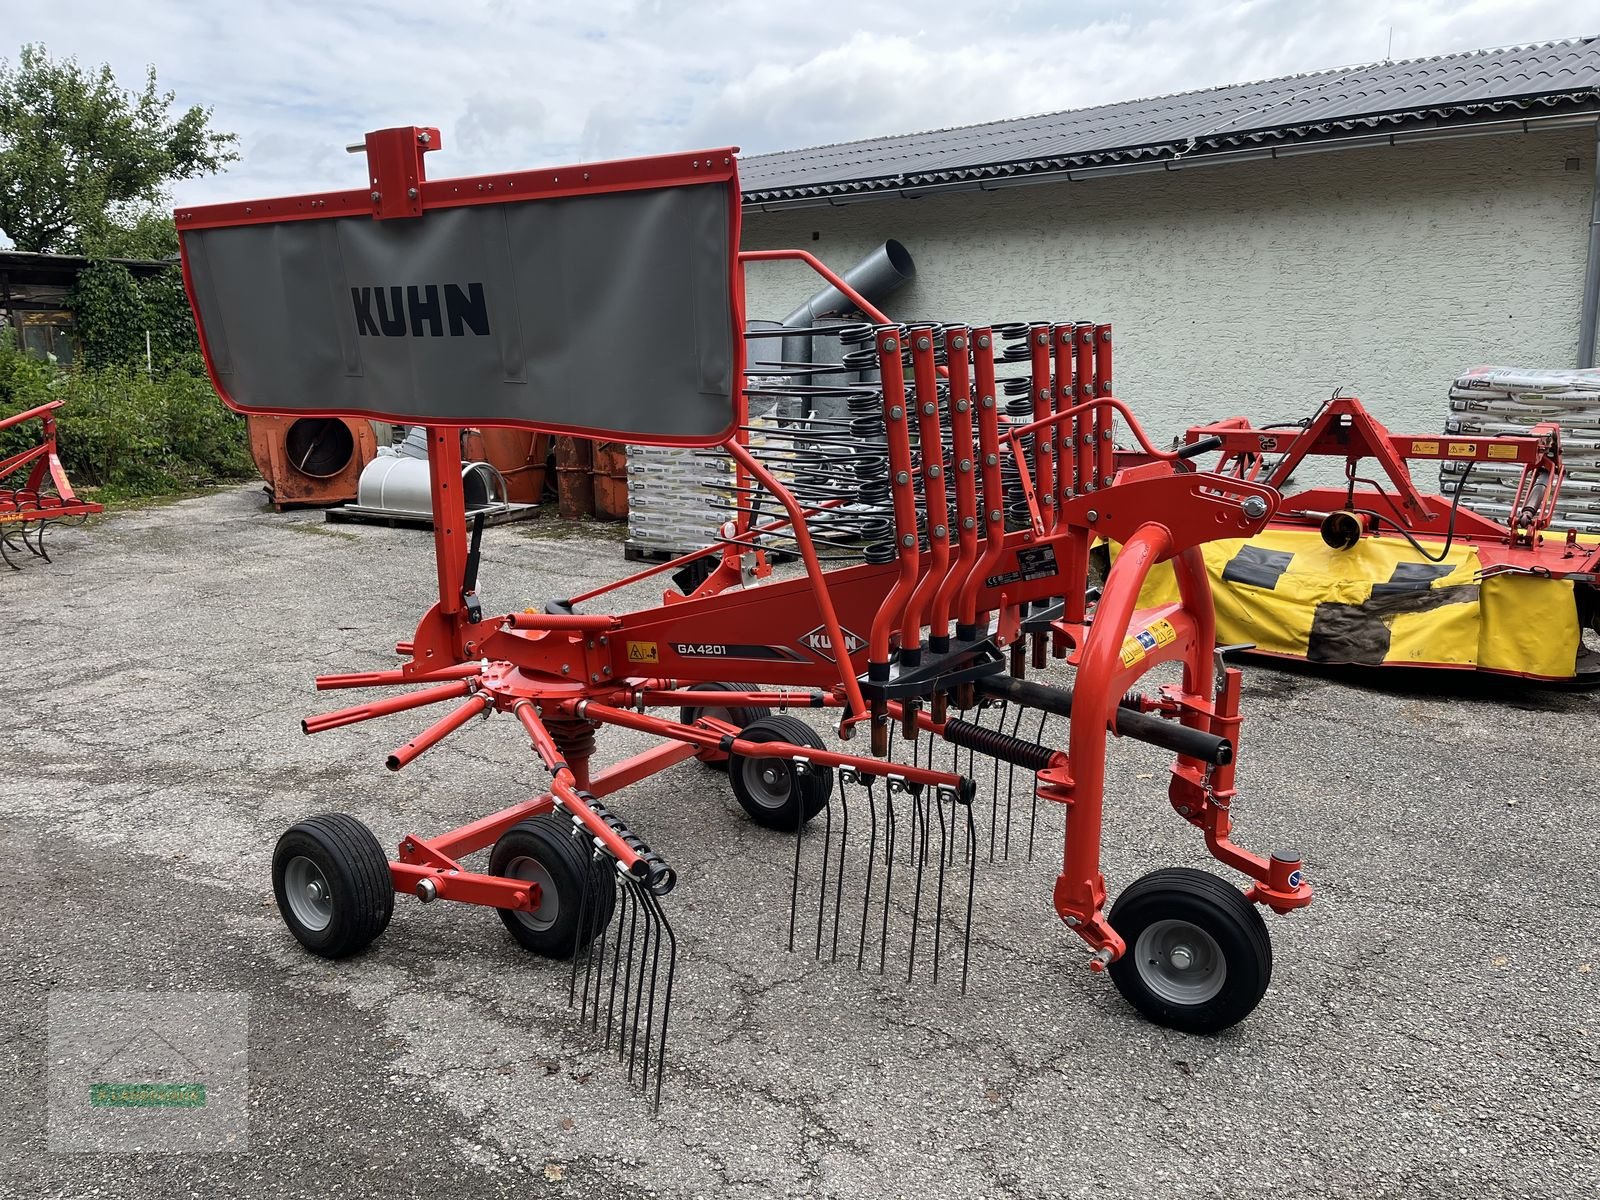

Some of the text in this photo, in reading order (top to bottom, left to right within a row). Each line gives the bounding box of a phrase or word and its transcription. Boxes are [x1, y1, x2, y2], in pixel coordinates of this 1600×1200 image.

[350, 283, 490, 337] KUHN
[678, 644, 727, 655] GA 4201
[809, 634, 857, 650] KUN
